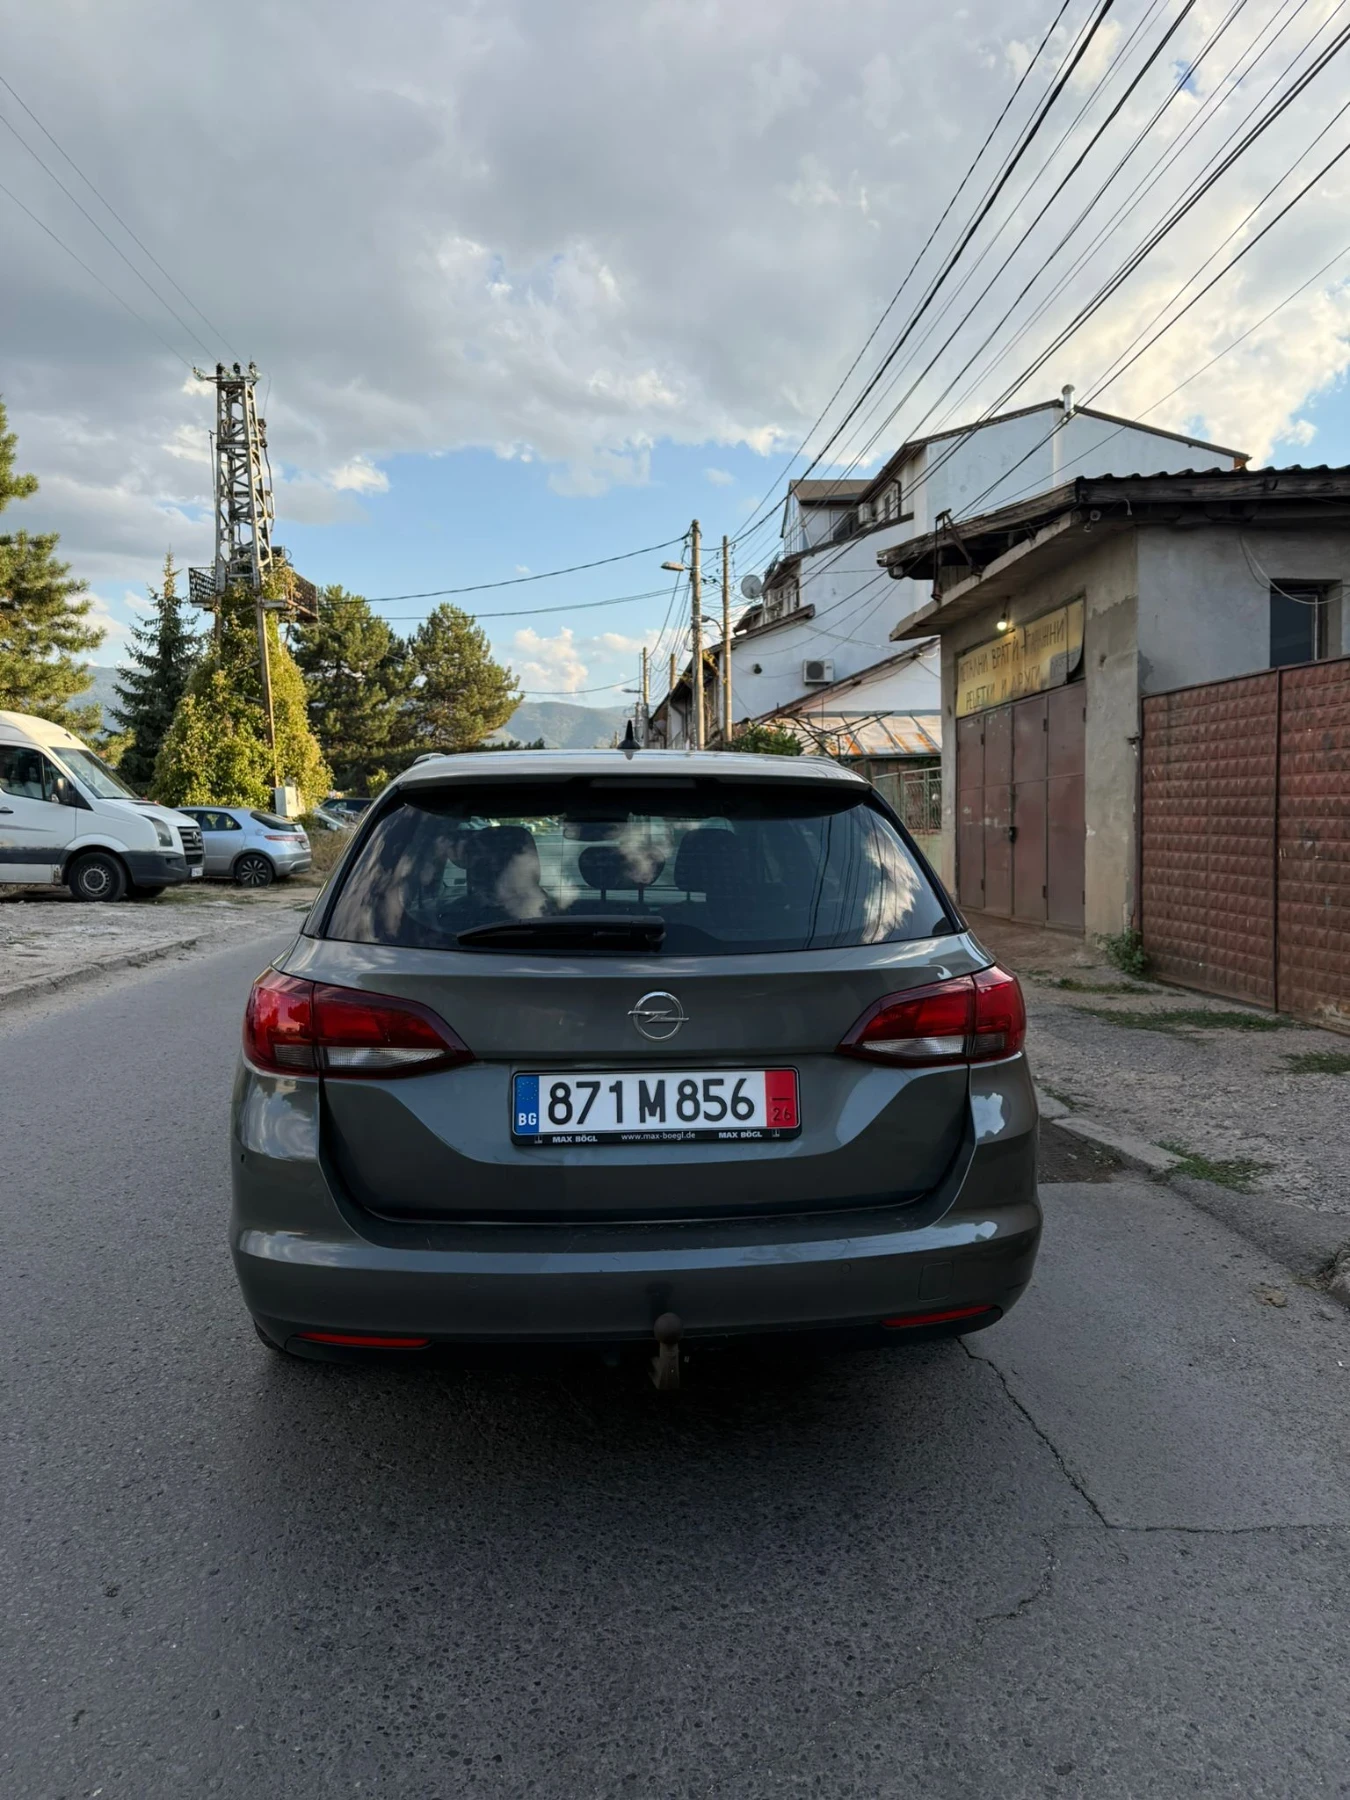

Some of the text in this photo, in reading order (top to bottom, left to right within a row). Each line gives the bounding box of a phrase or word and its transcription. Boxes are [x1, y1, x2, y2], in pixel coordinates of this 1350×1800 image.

[518, 1112, 537, 1126] BG
[772, 1107, 792, 1122] 26
[575, 1134, 598, 1143] BÖGL
[621, 1131, 696, 1140] www.max-boegl.de
[718, 1130, 763, 1139] MAX BÖGL
